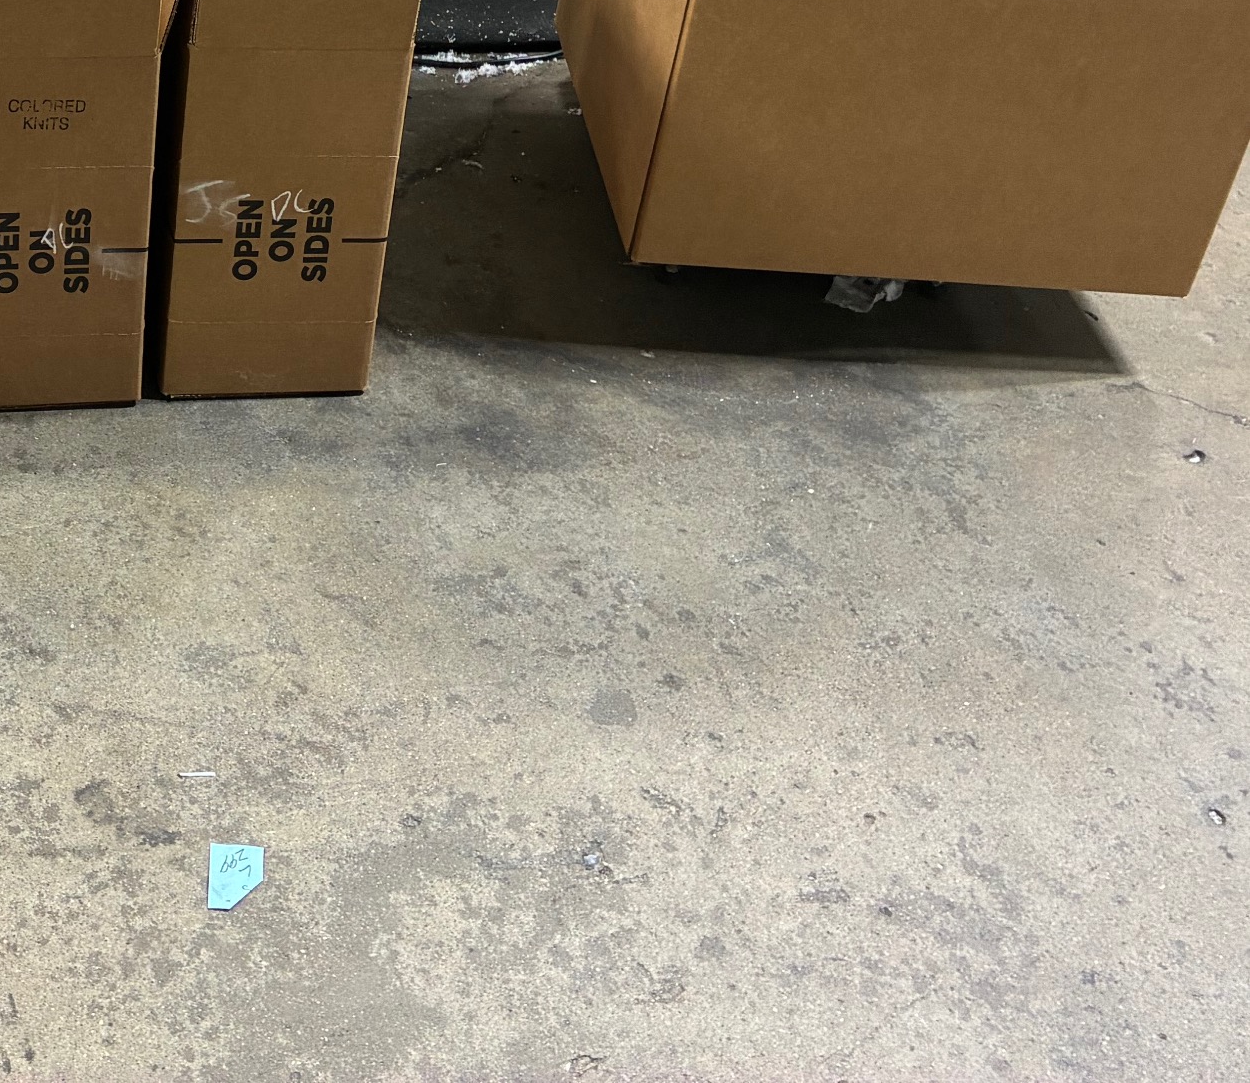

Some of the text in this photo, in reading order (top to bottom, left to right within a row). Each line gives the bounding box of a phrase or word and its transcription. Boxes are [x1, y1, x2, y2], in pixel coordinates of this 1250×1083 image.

[23, 116, 69, 130] KNITS
[28, 229, 55, 275] ON
[62, 208, 93, 294] SIDES
[231, 199, 265, 281] OPEN
[268, 218, 298, 263] ON
[300, 197, 336, 283] SIDES
